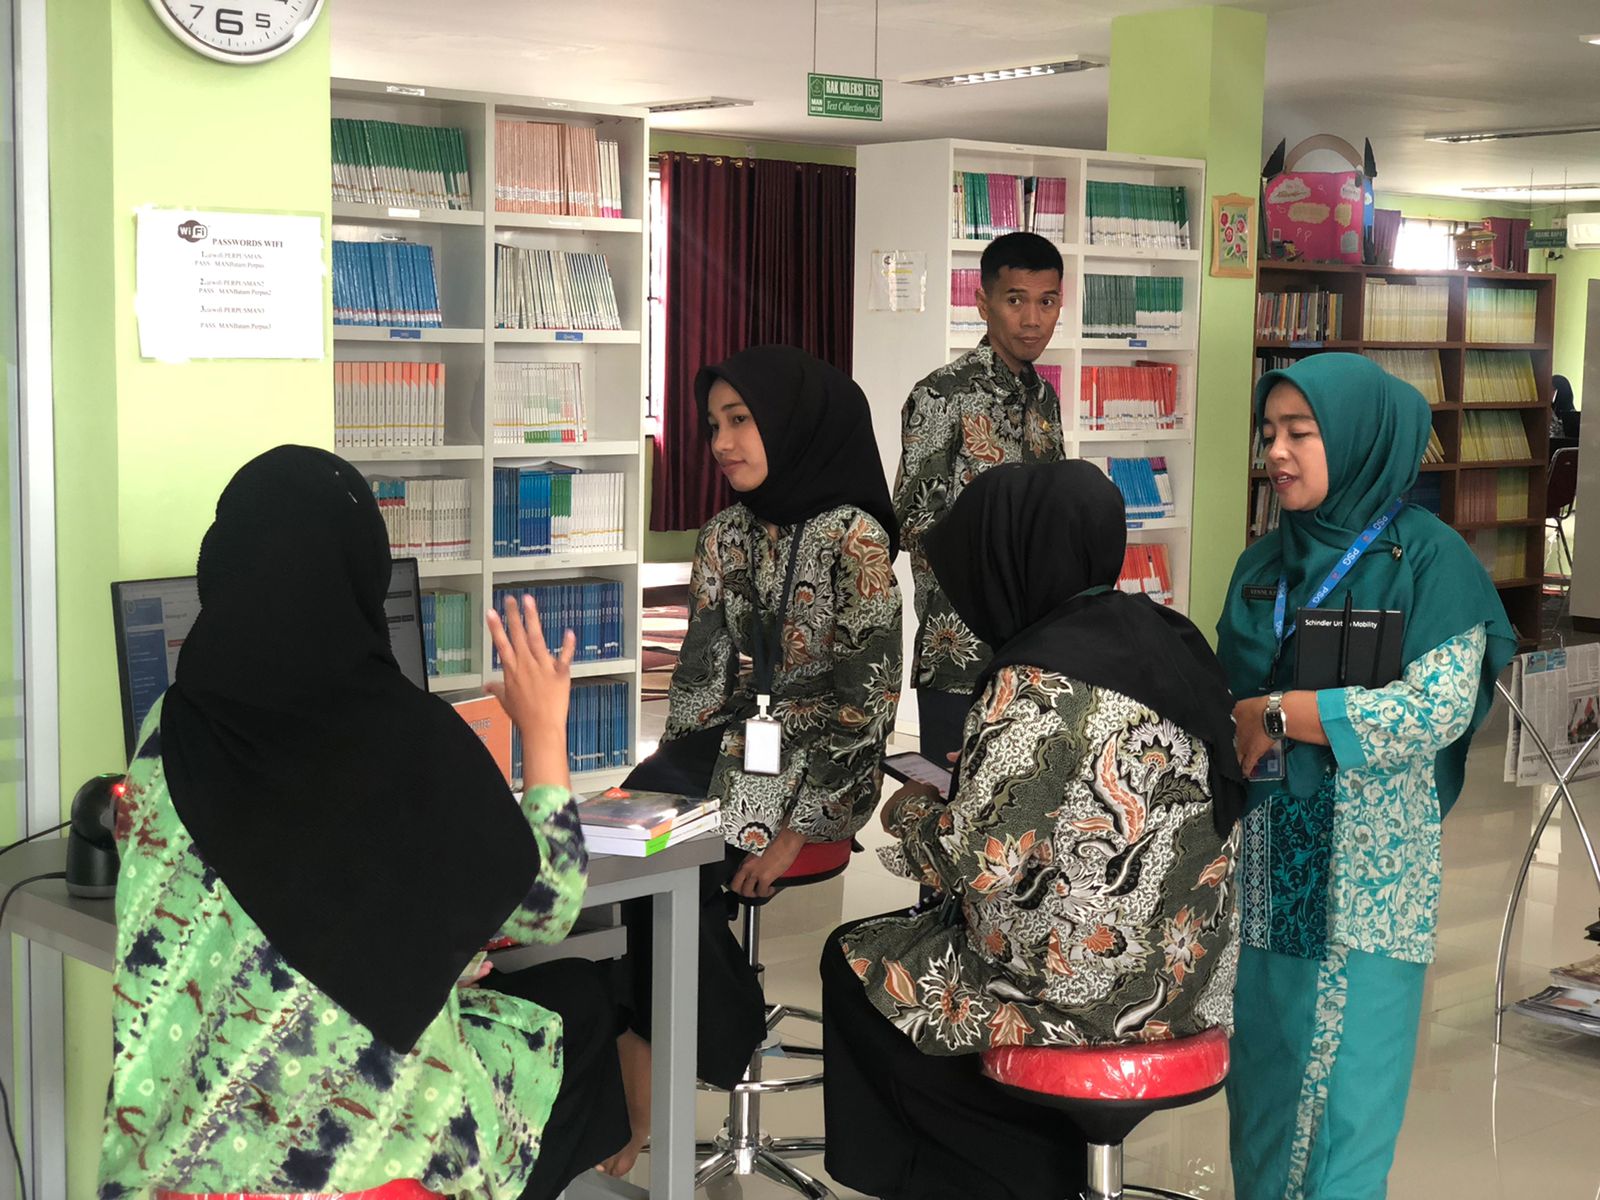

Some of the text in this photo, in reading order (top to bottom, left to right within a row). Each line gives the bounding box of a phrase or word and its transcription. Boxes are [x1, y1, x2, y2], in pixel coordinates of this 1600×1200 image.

[190, 4, 204, 19] 7
[215, 8, 244, 35] 6
[255, 12, 271, 28] 5
[826, 80, 879, 98] RAK KOLEKSI TEKS
[826, 101, 880, 116] Text Collection Shelf
[212, 239, 263, 247] PASSWORDS
[1372, 515, 1389, 530] PSG
[1342, 547, 1360, 566] PSG
[1312, 586, 1329, 604] PSG
[1304, 619, 1332, 627] Schindler
[1352, 621, 1378, 630] Mobility
